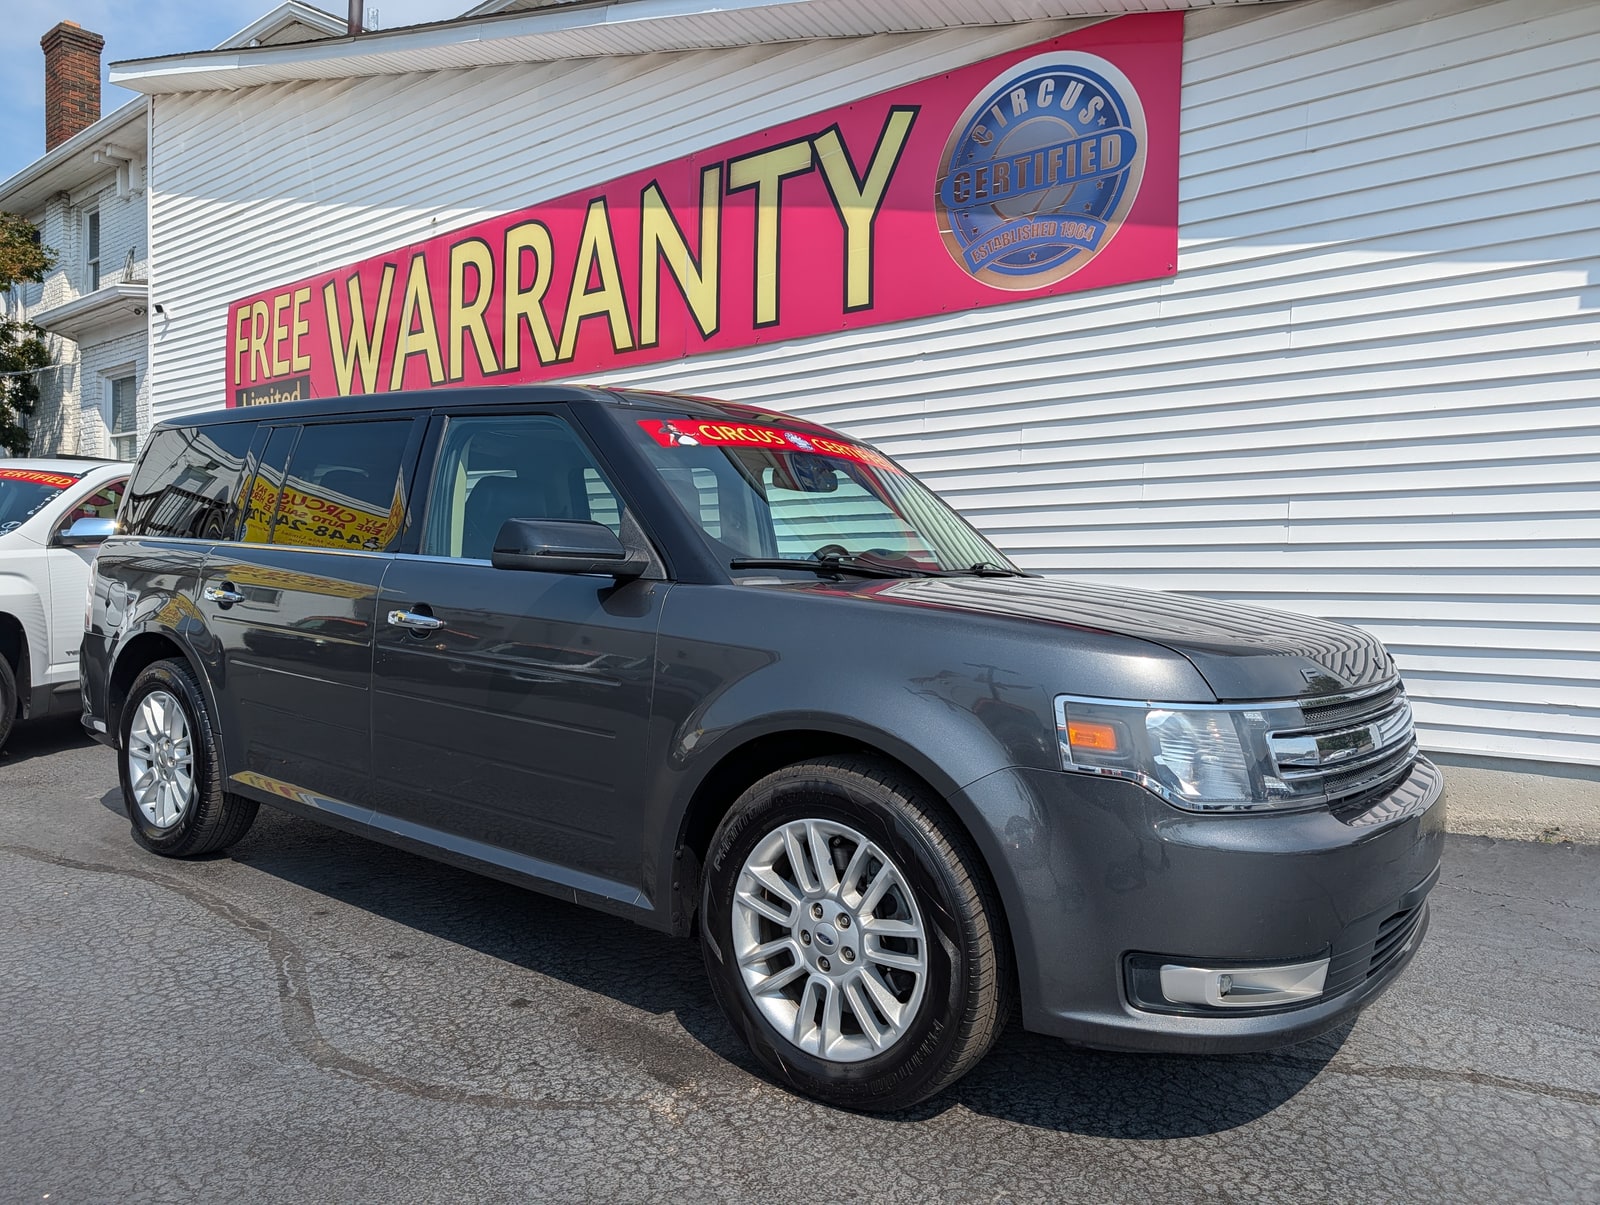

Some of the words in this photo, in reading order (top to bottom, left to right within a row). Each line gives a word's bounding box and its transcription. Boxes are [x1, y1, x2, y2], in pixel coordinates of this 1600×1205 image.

[972, 78, 1105, 147] CIRCUS
[953, 134, 1122, 204] CERTIFIED
[234, 286, 311, 386] FREE
[322, 105, 921, 395] WARRANTY
[972, 222, 1057, 263] ESTABLISHED
[1060, 221, 1096, 243] 1964
[242, 381, 301, 408] Limited
[698, 424, 786, 445] CIRCUS
[0, 470, 72, 485] ERTIFIED
